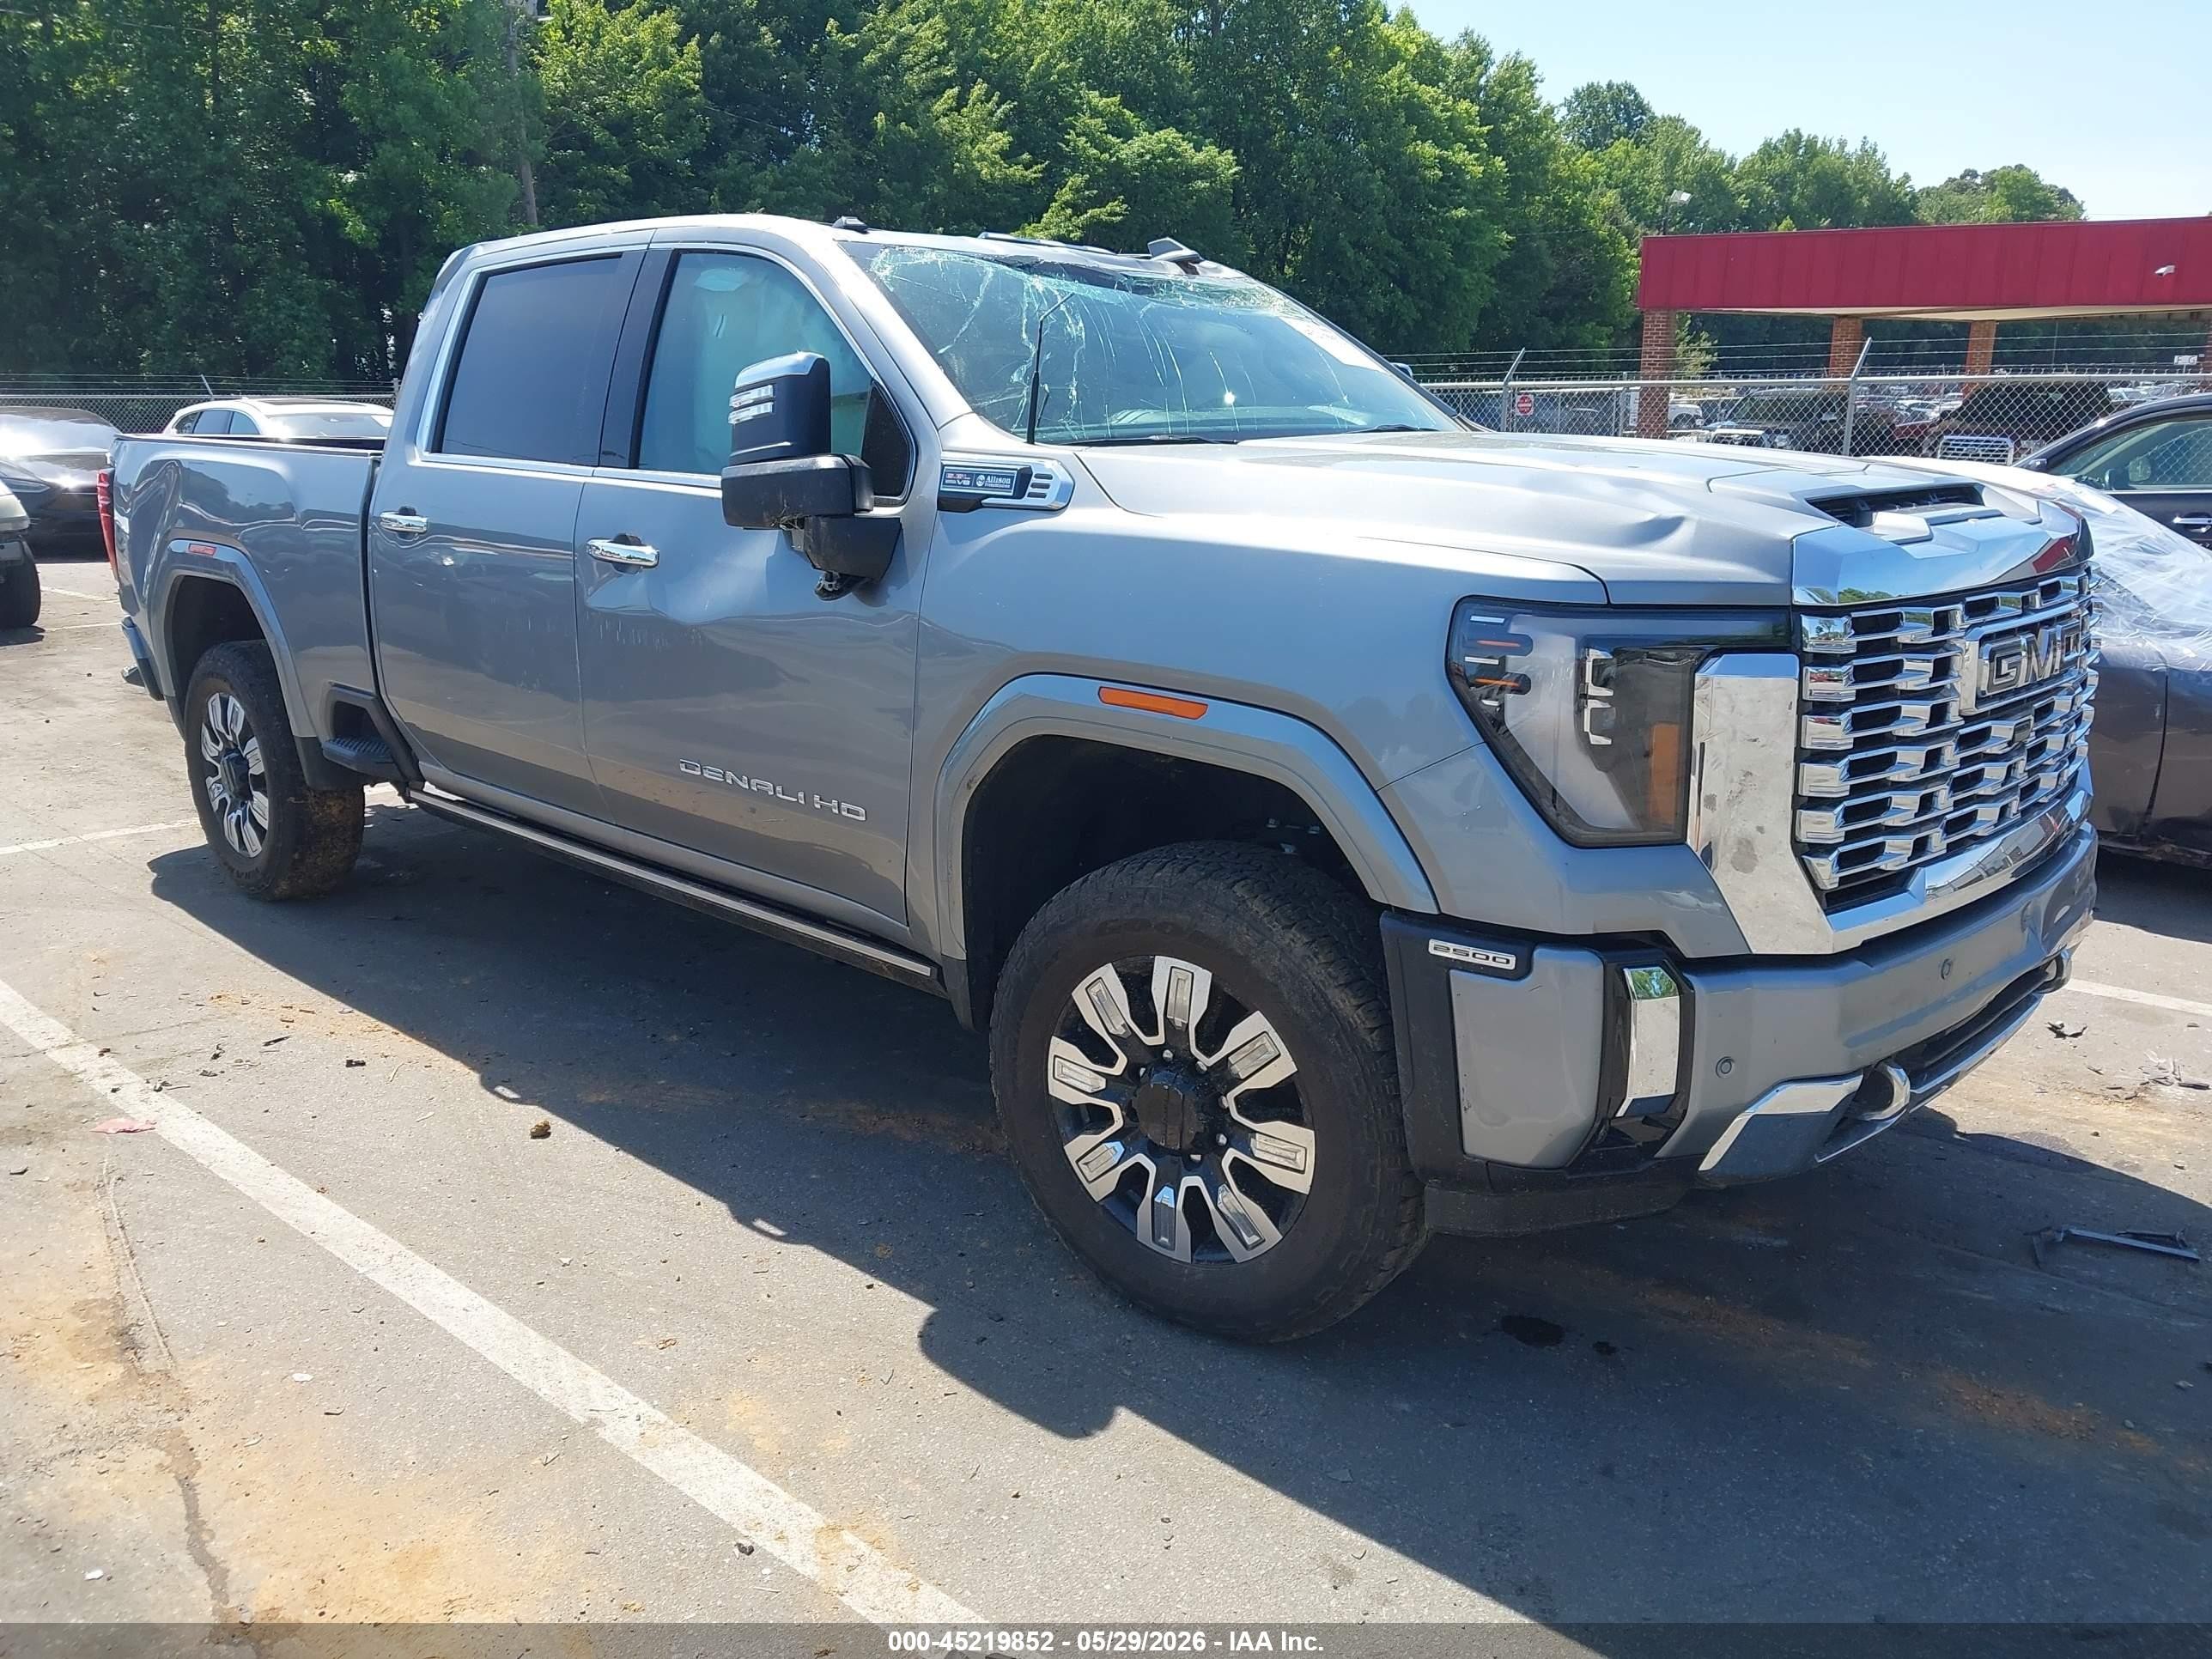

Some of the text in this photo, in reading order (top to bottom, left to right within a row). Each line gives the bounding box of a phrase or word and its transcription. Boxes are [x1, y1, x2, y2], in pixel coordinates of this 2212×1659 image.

[986, 476, 1011, 484] Allison
[1978, 617, 2081, 697] GMC
[679, 758, 866, 821] DENALI HD
[1432, 944, 1510, 965] 2500
